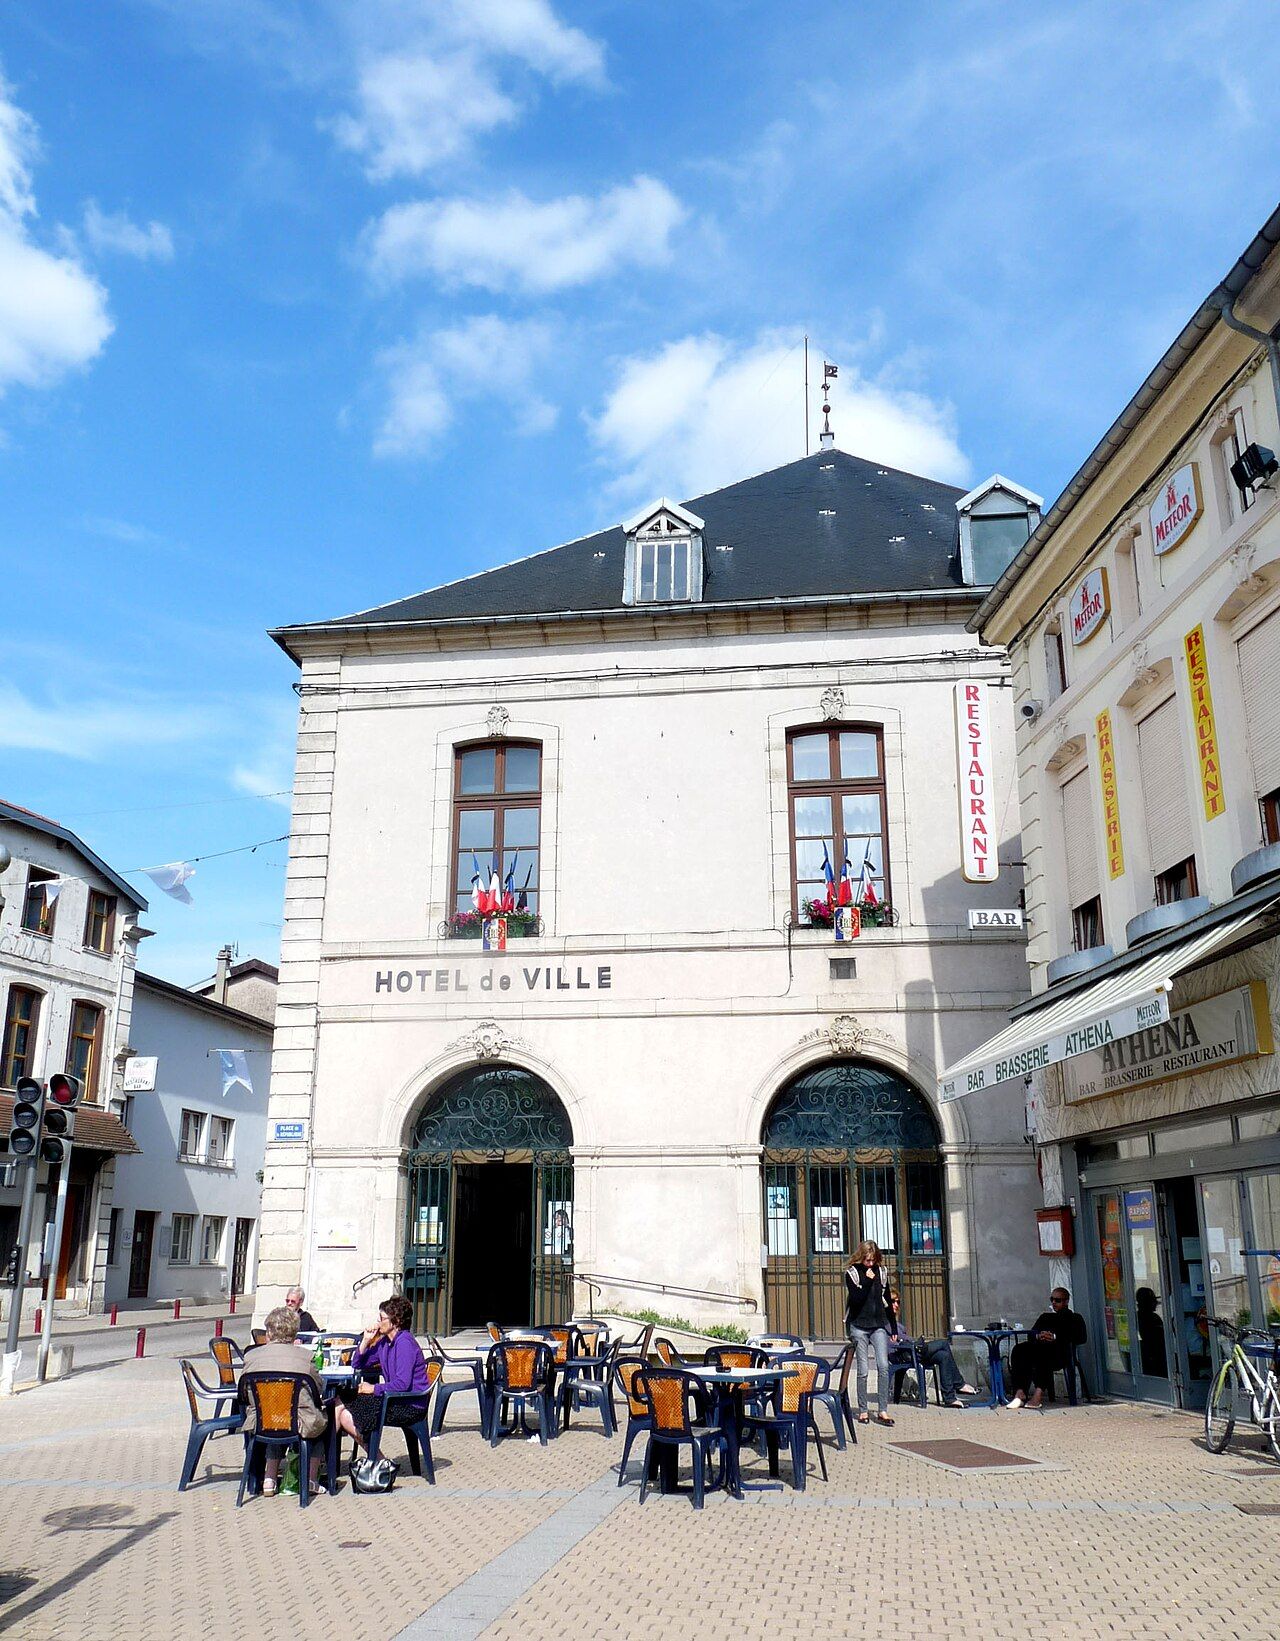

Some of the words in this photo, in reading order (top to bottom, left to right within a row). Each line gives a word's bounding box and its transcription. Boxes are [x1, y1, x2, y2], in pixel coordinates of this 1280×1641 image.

[1155, 494, 1193, 547] METEOR
[1074, 592, 1102, 637] METEOR
[1187, 630, 1220, 814] RESTAURANT
[965, 685, 988, 874] RESTAURANT
[1097, 714, 1121, 874] BRASSERIE
[976, 912, 1018, 925] BAR
[375, 969, 469, 993] HOTEL
[480, 968, 511, 991] de
[522, 966, 611, 990] VILLE
[1136, 1000, 1161, 1022] METEOR
[967, 1070, 985, 1091] BAR
[995, 1044, 1050, 1082] BRASSERIE
[1065, 1019, 1114, 1056] ATHENA
[1079, 1082, 1097, 1096] BAR
[1104, 1064, 1154, 1089] BRASSERIE
[1163, 1039, 1236, 1072] RESTAURANT
[1101, 1012, 1201, 1074] ATHENA
